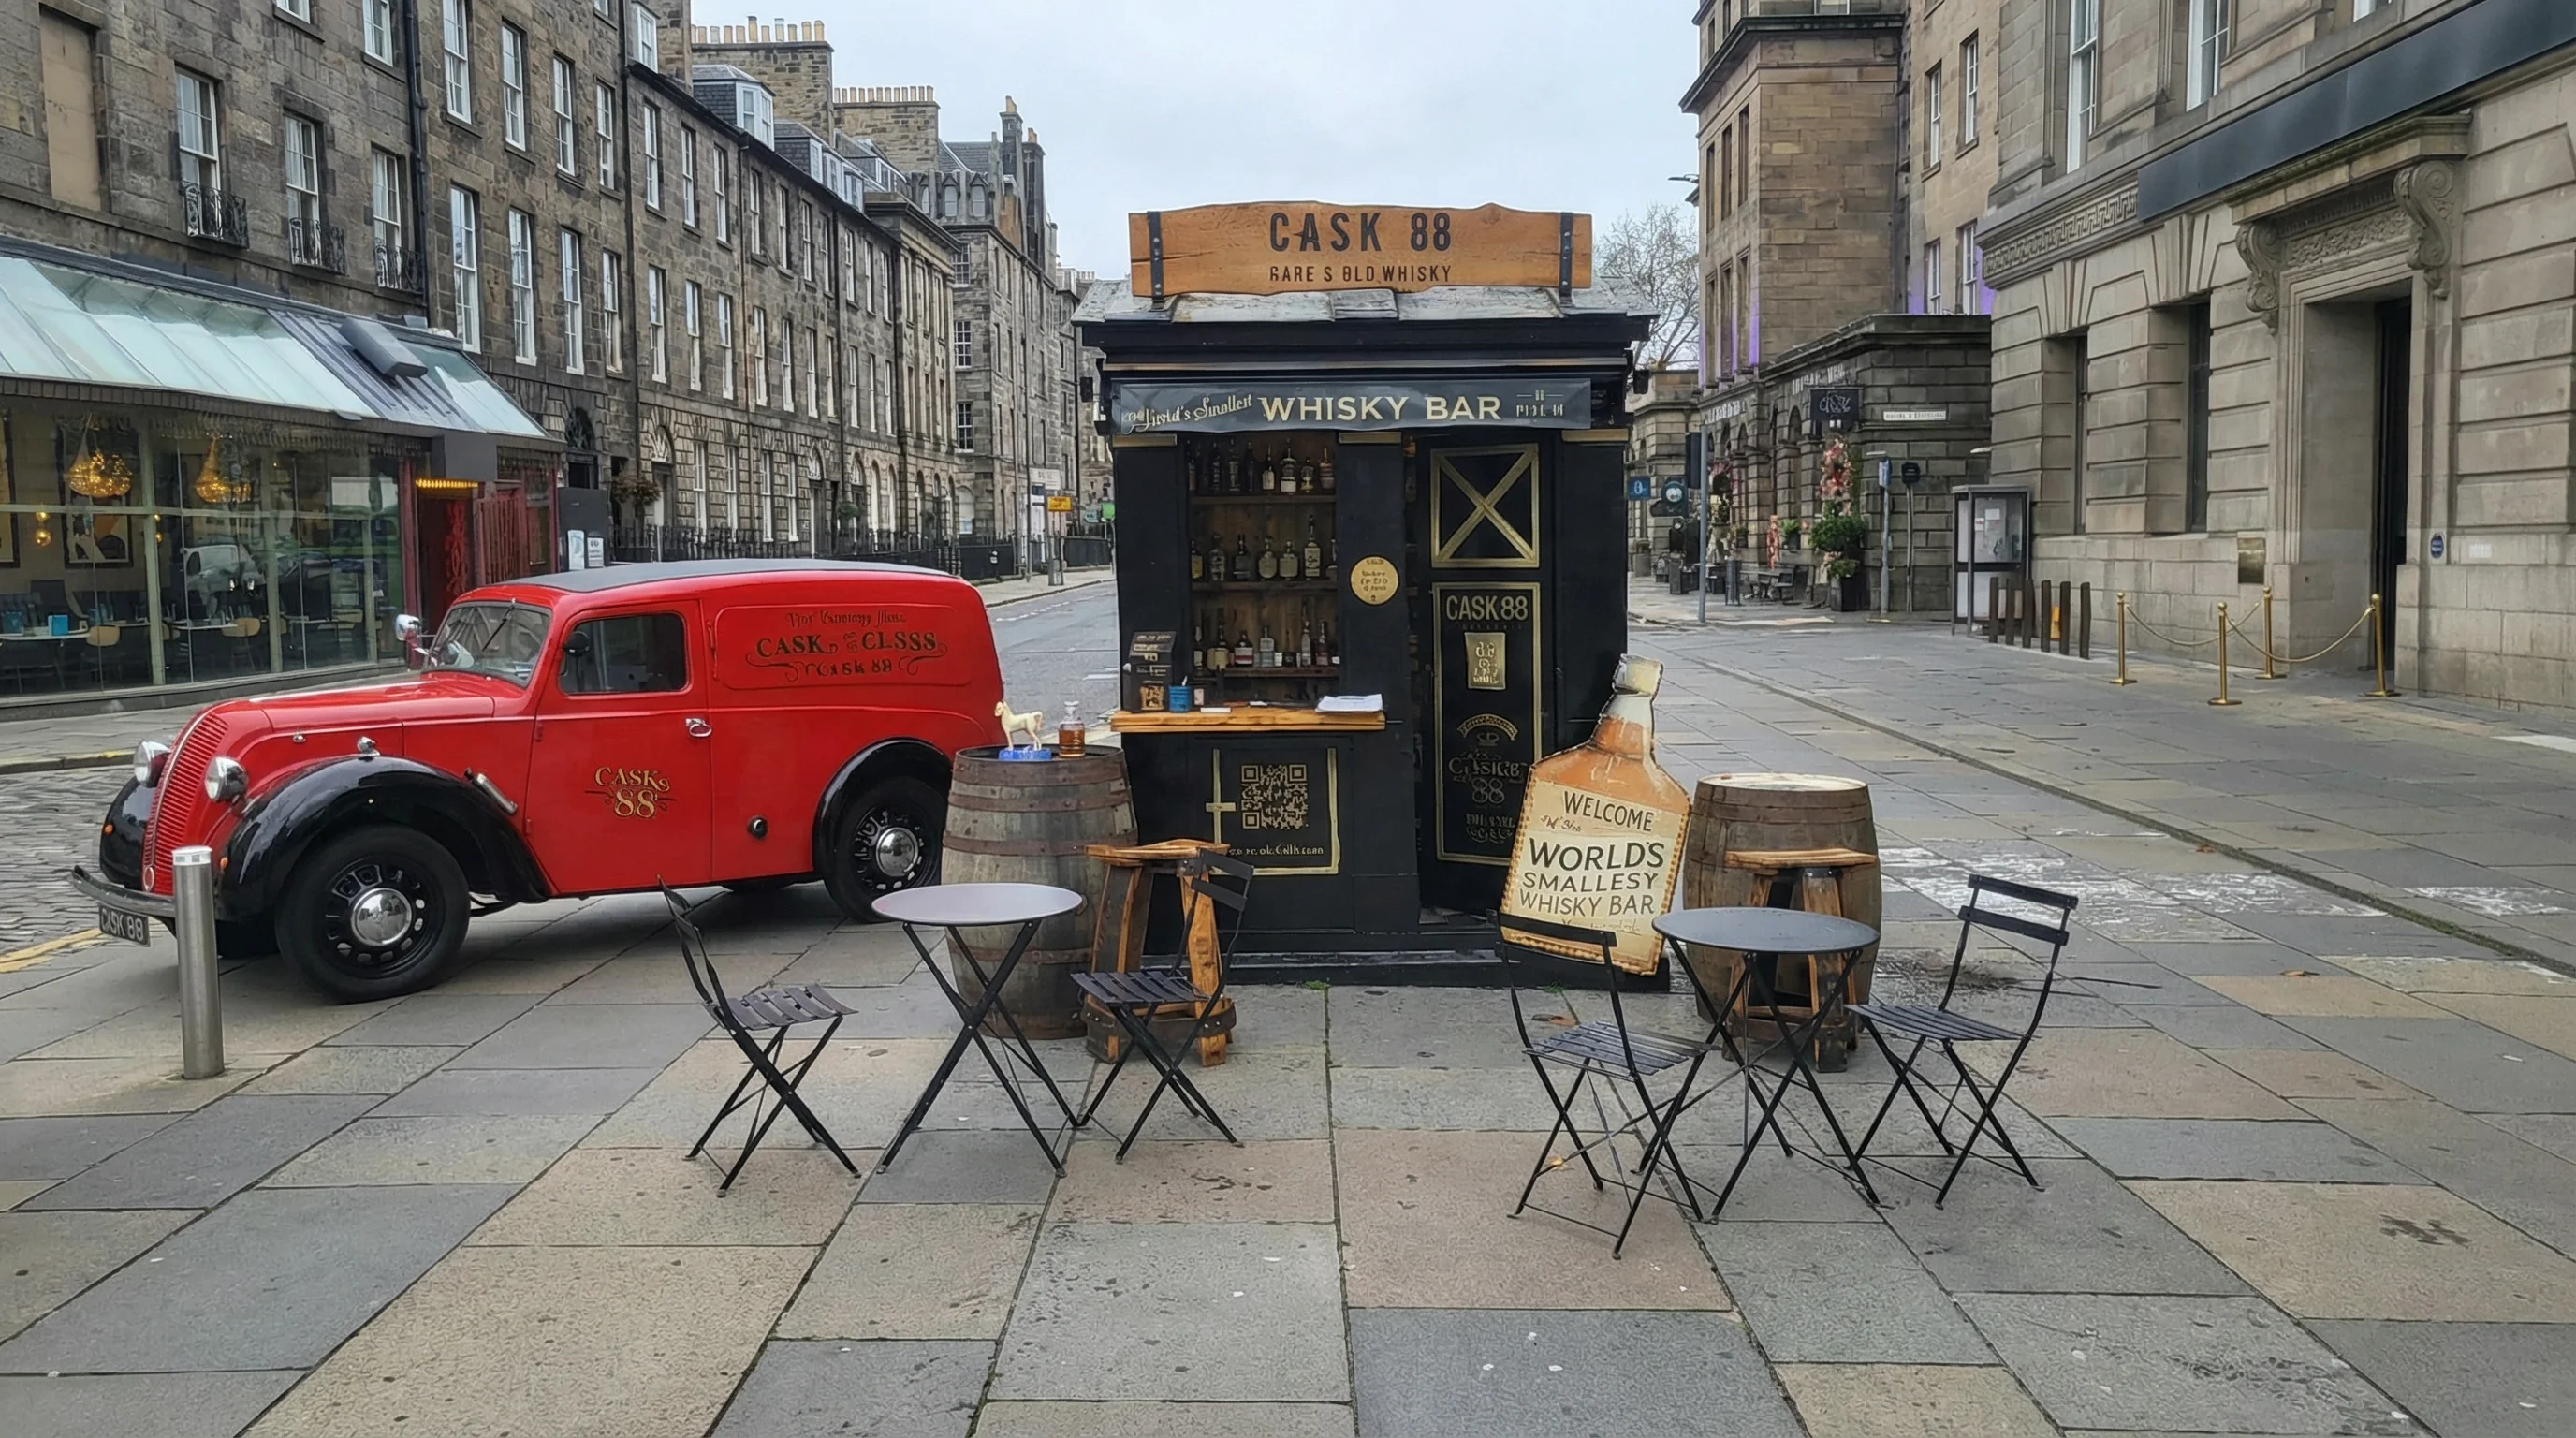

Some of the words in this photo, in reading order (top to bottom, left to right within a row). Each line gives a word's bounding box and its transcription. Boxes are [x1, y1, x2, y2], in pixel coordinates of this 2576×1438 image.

[1270, 213, 1382, 252] CASK
[1411, 213, 1451, 252] 88
[1383, 265, 1452, 282] WHISKY
[1257, 396, 1409, 421] WHISKY
[1424, 396, 1502, 420] BAR
[1446, 595, 1500, 620] CASK
[1500, 596, 1529, 621] 88
[756, 634, 838, 657] CASK
[594, 767, 670, 792] CASK
[614, 787, 655, 818] 88
[1564, 791, 1655, 832] WELCOME
[1519, 888, 1602, 917] WHISKY
[1609, 895, 1655, 916] BAR
[127, 916, 144, 942] 88
